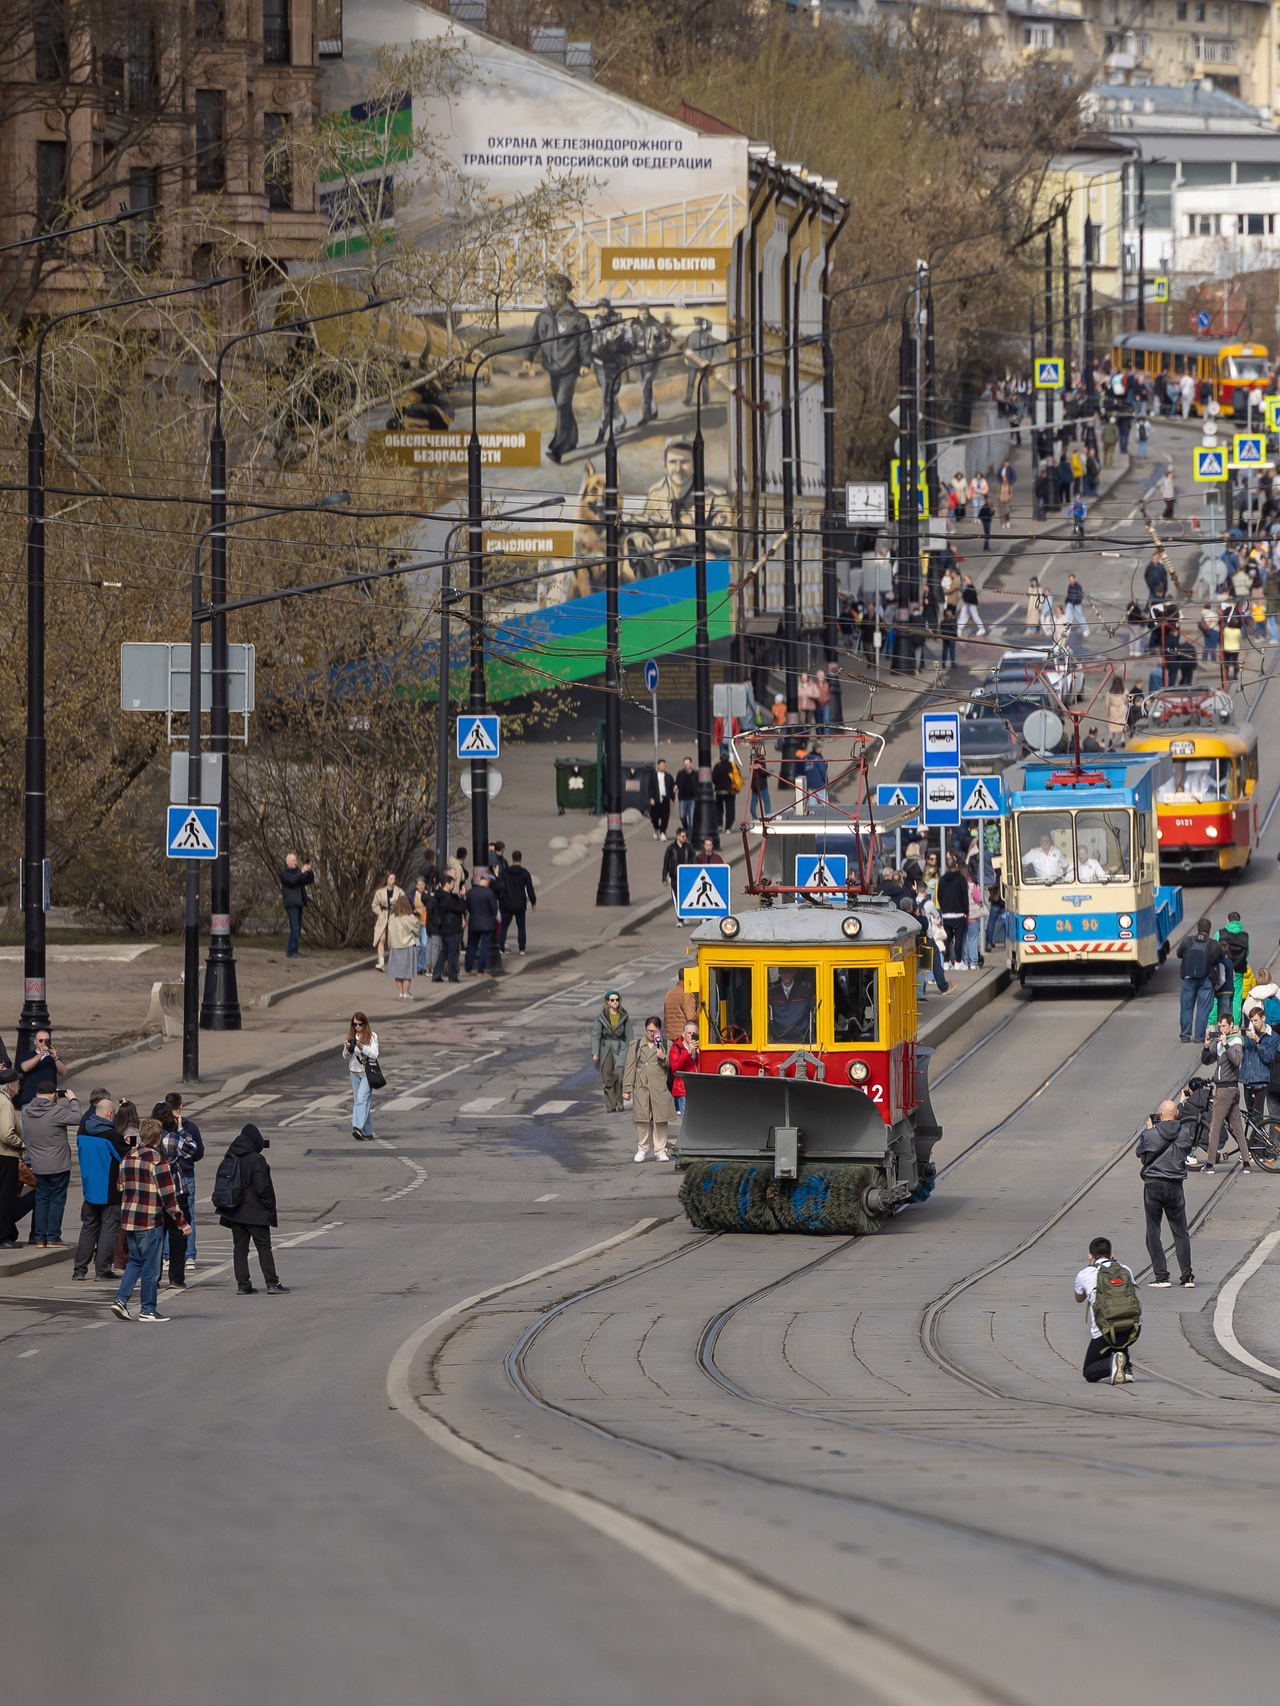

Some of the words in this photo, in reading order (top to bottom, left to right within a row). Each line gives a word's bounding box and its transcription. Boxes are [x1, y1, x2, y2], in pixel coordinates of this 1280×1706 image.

[488, 137, 537, 149] ОХРАНА
[541, 138, 683, 151] ЖЕЛЕЗНОДОРОЖНОГО
[463, 154, 543, 167] ТРАНСПОРТА
[546, 153, 629, 168] РОССИЙСКОЙ
[632, 156, 712, 169] ФЕДЕРАЦИИ
[612, 256, 656, 271] ОХРАНА
[657, 256, 716, 271] ОБЪЕКТОВ
[385, 434, 461, 448] ОБЕСПЕЧЕНИЕ
[463, 431, 526, 448] ПЖАРНОЙ
[413, 449, 502, 463] БЕЗОПАССТИ
[1175, 818, 1193, 827] 0121
[1056, 919, 1073, 932] 34
[1082, 918, 1099, 931] 90
